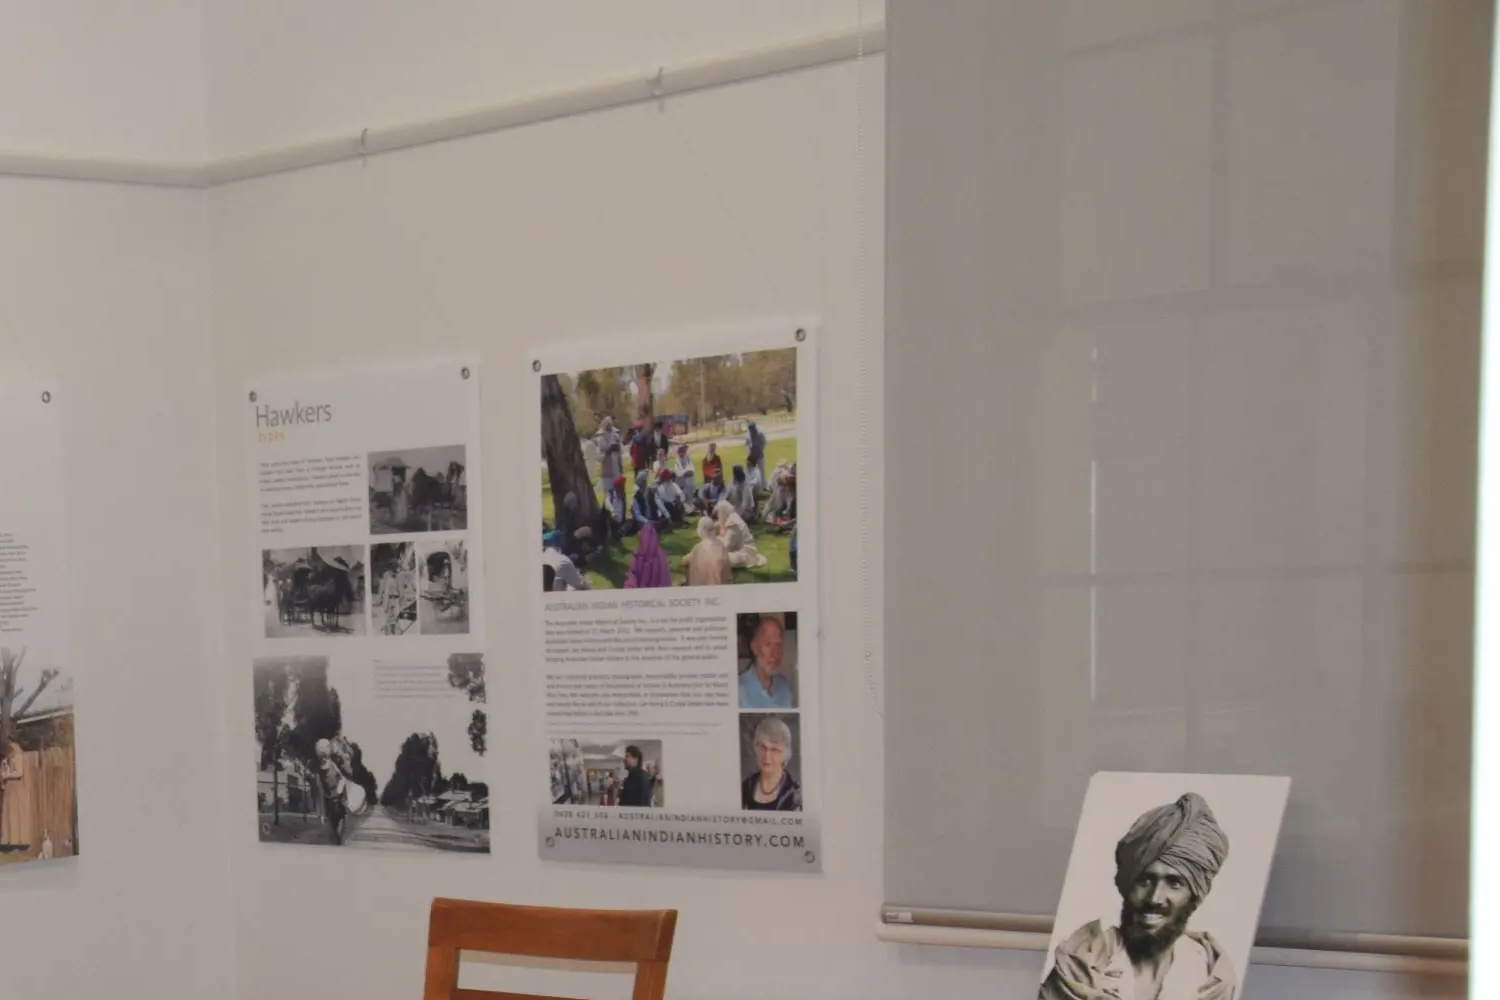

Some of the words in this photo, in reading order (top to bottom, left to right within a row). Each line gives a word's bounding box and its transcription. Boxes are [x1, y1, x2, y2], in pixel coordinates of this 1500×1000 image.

[256, 401, 333, 428] Hawkers
[669, 598, 700, 607] SOCIETY
[554, 826, 805, 848] AUSTRALIANINDIANHISTORY.COM
